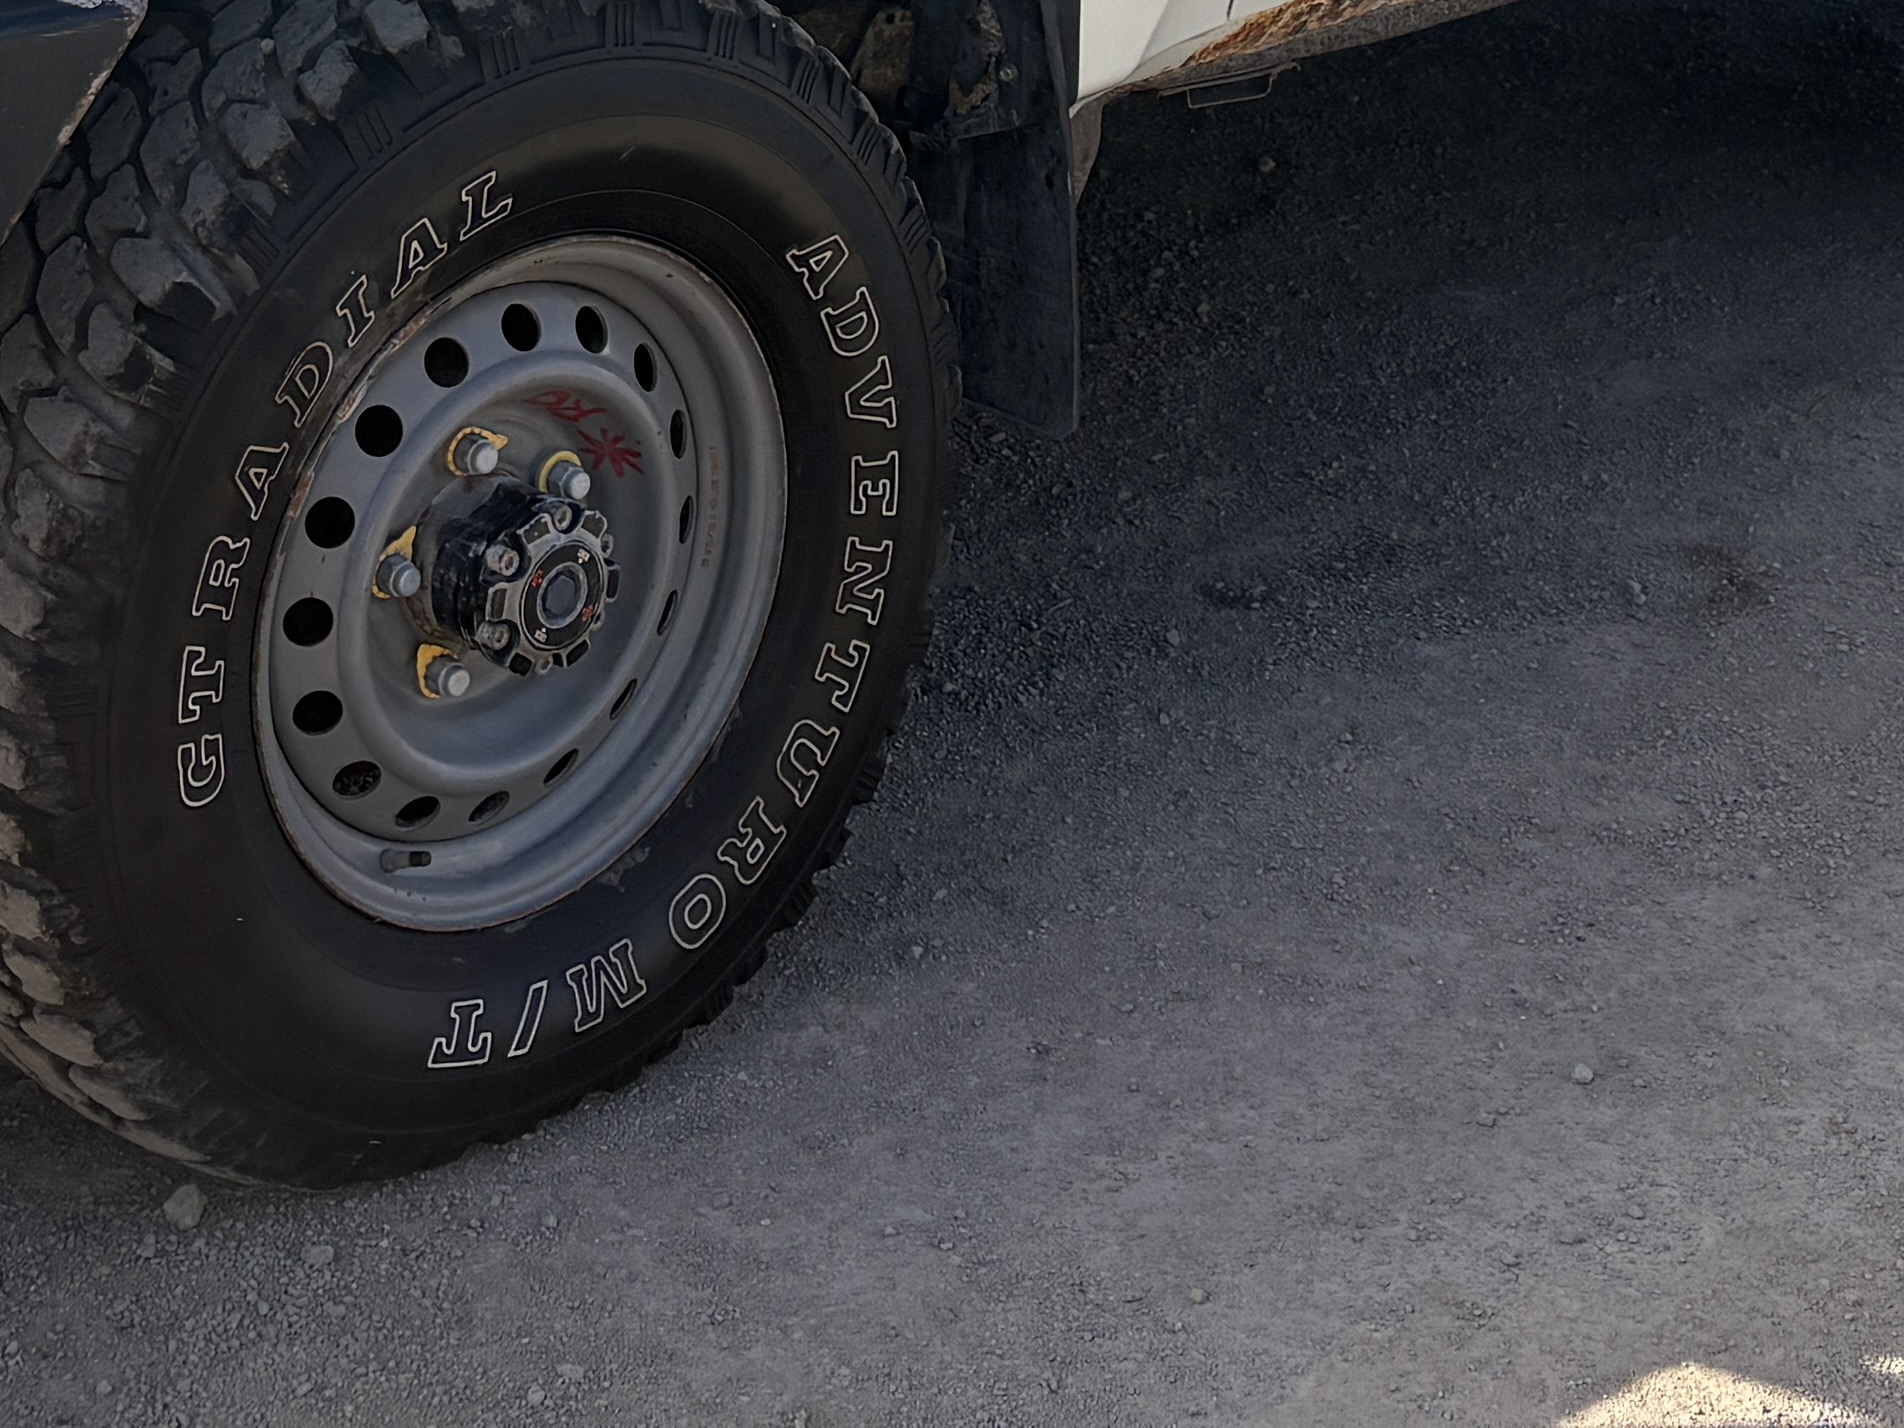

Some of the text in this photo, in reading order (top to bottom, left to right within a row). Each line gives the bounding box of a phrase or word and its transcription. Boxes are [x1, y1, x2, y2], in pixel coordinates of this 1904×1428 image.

[190, 169, 514, 622] RADIAL
[427, 233, 900, 1070] ADVENTURO M/T
